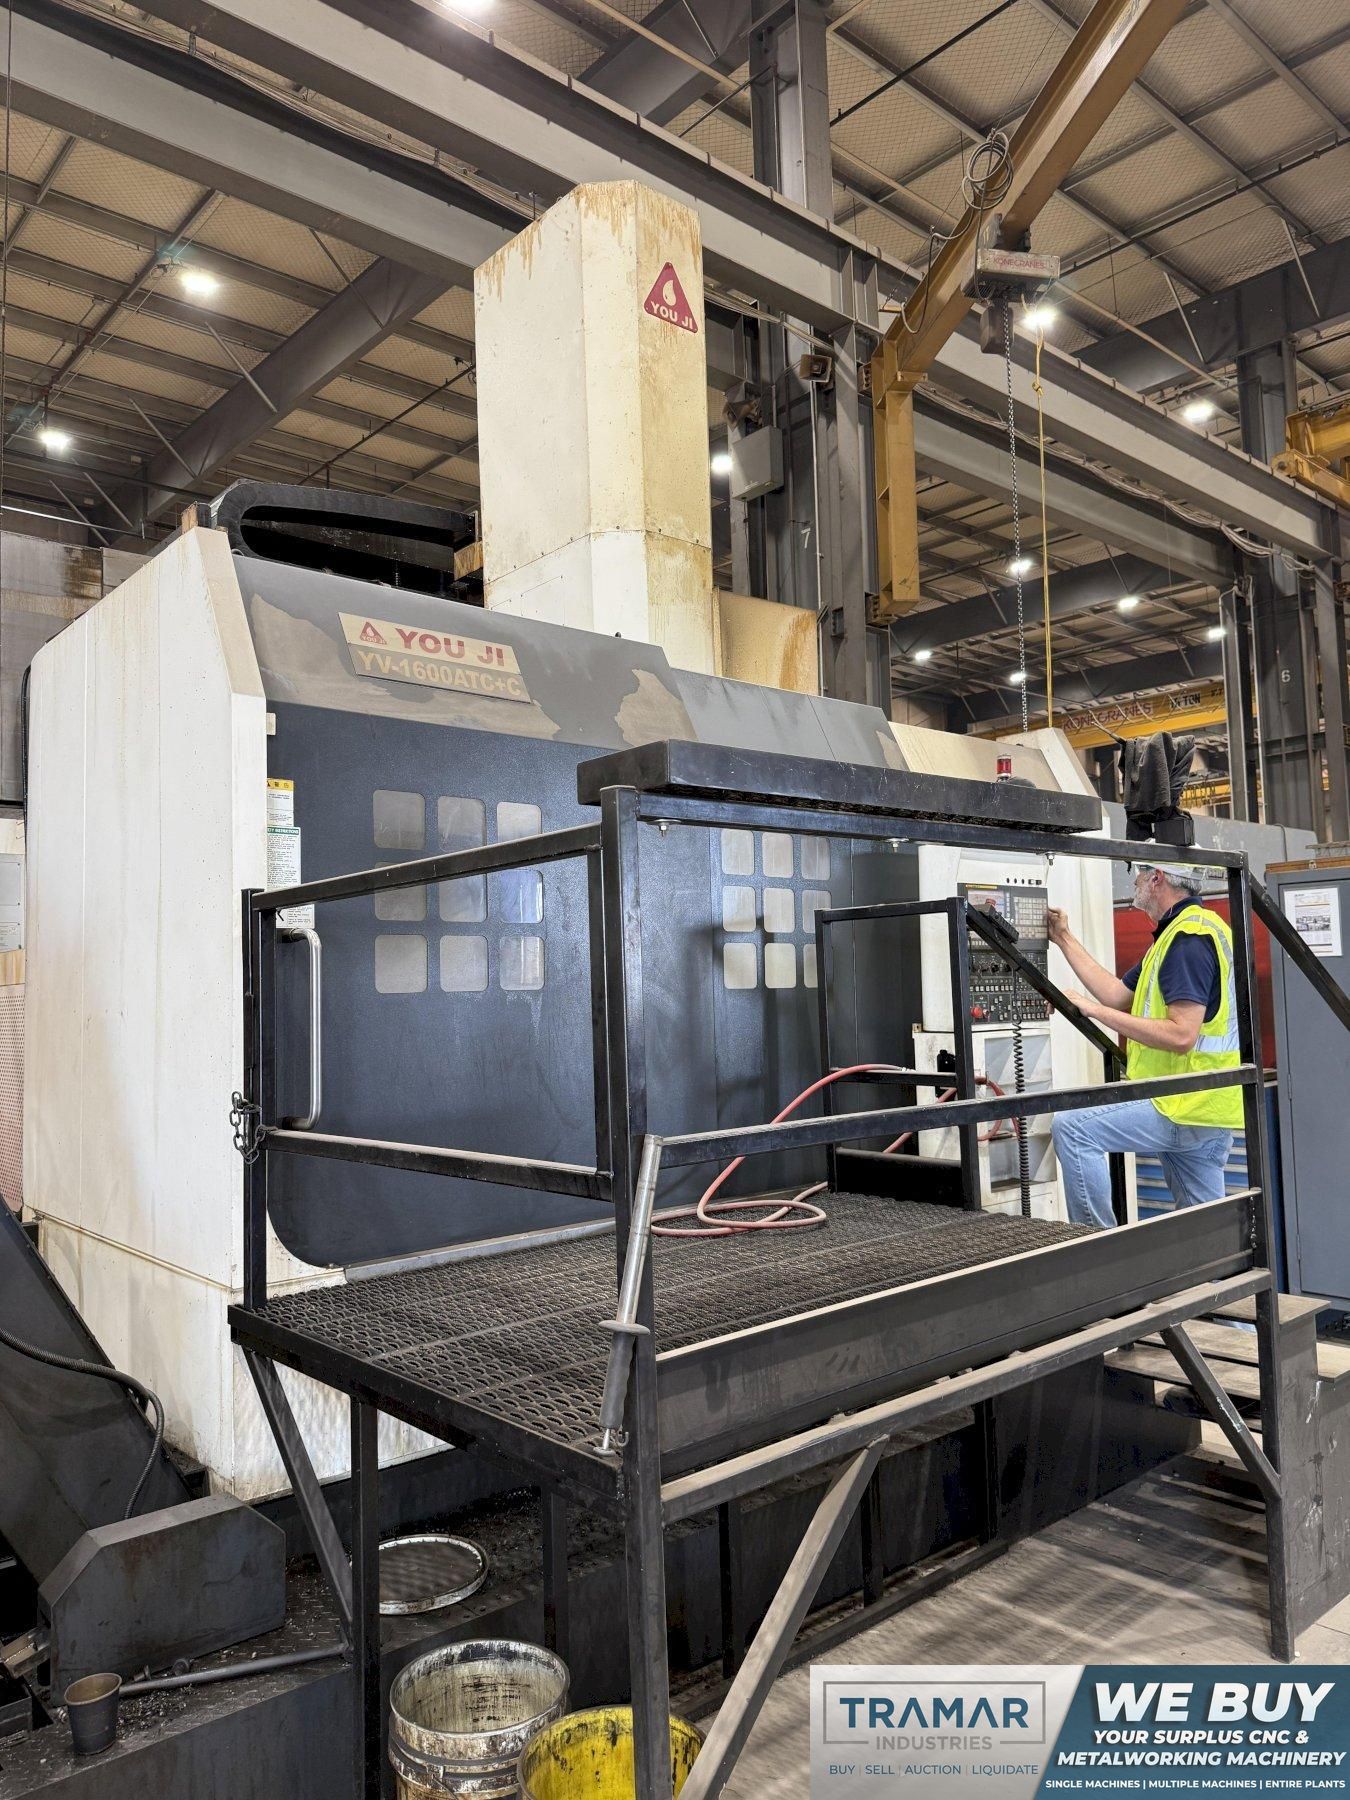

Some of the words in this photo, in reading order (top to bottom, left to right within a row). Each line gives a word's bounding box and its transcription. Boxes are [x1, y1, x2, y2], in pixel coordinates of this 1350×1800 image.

[993, 256, 1046, 270] KONECRANES
[650, 301, 678, 322] YOU
[682, 316, 694, 330] JI
[801, 528, 811, 549] 7
[361, 635, 377, 643] YOU
[395, 628, 465, 659] YOU
[477, 646, 505, 667] JI
[357, 650, 522, 696] YV-1600ATC+C
[1281, 670, 1291, 683] 6
